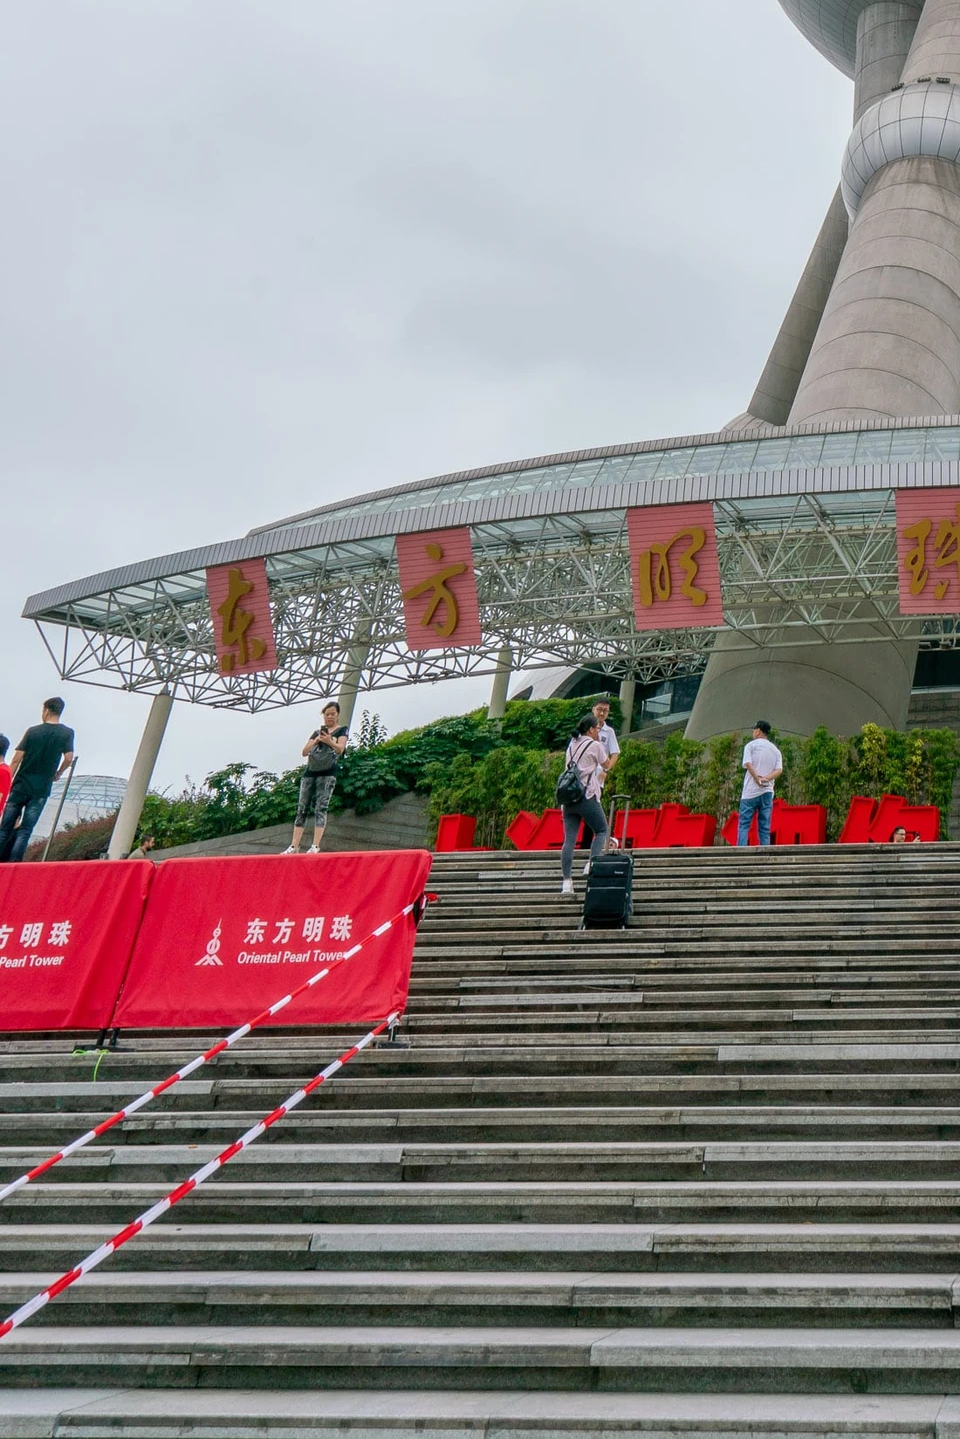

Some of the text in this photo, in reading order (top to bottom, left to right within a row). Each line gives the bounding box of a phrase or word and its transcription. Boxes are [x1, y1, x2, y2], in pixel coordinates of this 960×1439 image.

[243, 914, 353, 945] 东方明珠
[0, 954, 65, 969] Pearl Tower
[237, 951, 282, 964] Oriental
[282, 950, 311, 963] Pearl
